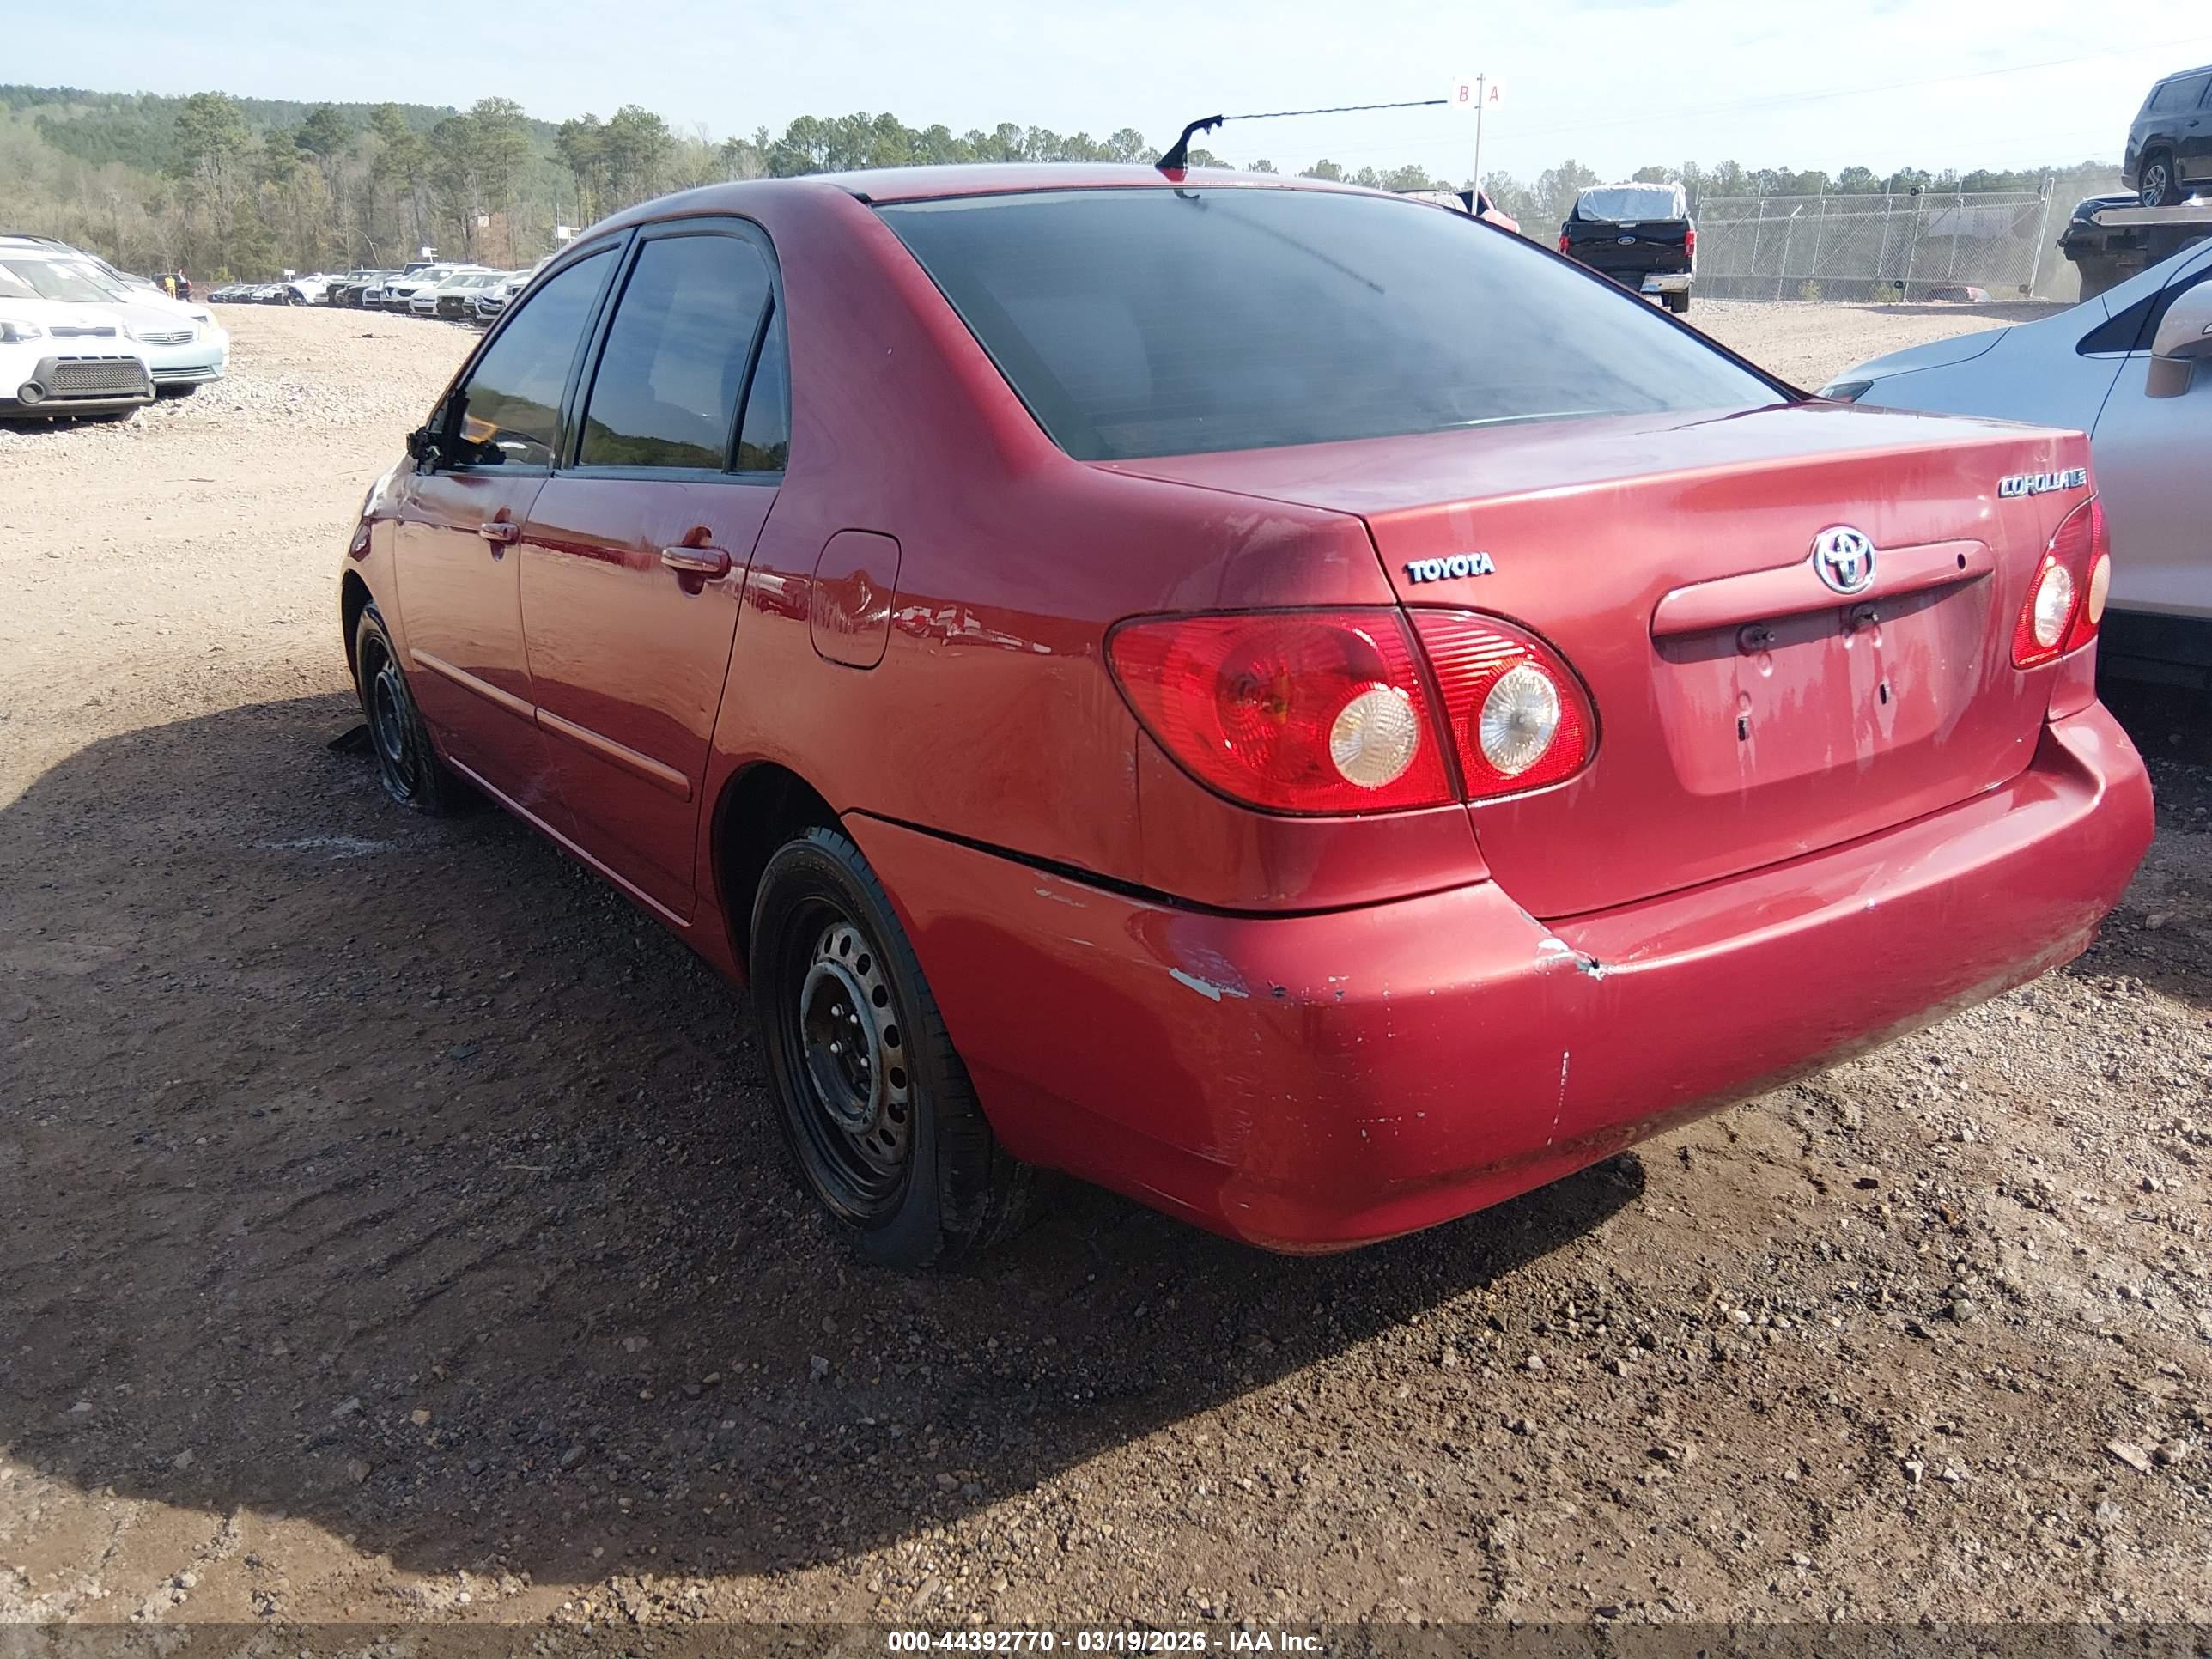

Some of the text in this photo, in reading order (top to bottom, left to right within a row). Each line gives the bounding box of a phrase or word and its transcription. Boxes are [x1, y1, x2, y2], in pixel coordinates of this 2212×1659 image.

[1459, 85, 1469, 102] B
[1489, 85, 1498, 102] A
[1997, 470, 2070, 497] COROLLA
[1404, 551, 1496, 583] TOYOTA
